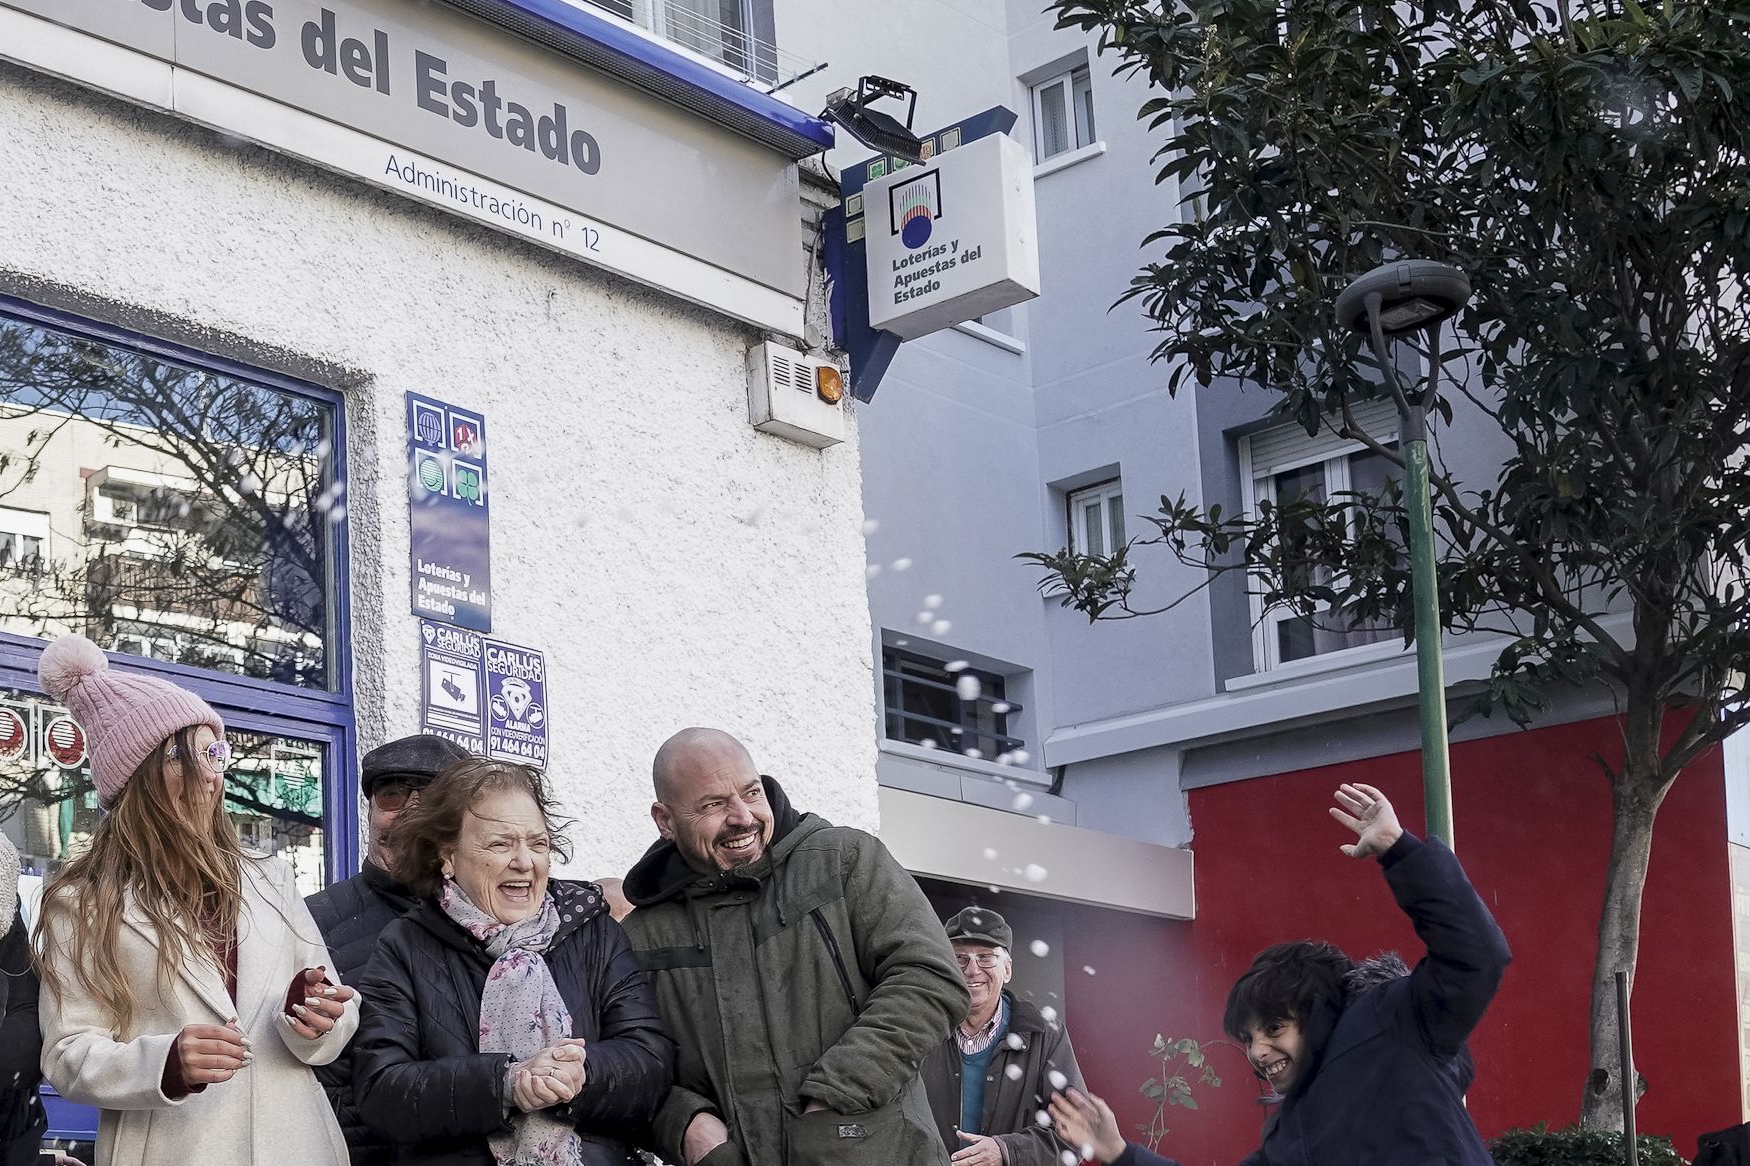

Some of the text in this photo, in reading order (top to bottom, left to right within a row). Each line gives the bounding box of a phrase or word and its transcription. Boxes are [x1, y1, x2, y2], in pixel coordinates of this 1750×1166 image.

[300, 7, 391, 96] del
[415, 49, 601, 175] Estado
[385, 154, 542, 231] Administración
[581, 226, 600, 253] 12
[892, 239, 959, 272] Loterías y
[893, 245, 982, 289] Apuestas del
[894, 279, 941, 305] Estado
[417, 558, 470, 588] Loterías y
[418, 576, 486, 606] Apuestas del
[417, 593, 455, 616] Estado
[436, 627, 480, 650] CARLÚS
[437, 638, 481, 658] SEGURIDAD
[487, 647, 542, 672] CARLÚS
[487, 660, 542, 683] SEGURIDAD
[504, 719, 531, 733] ALARMA
[470, 738, 483, 753] 04
[490, 735, 545, 760] 91 464 64 04
